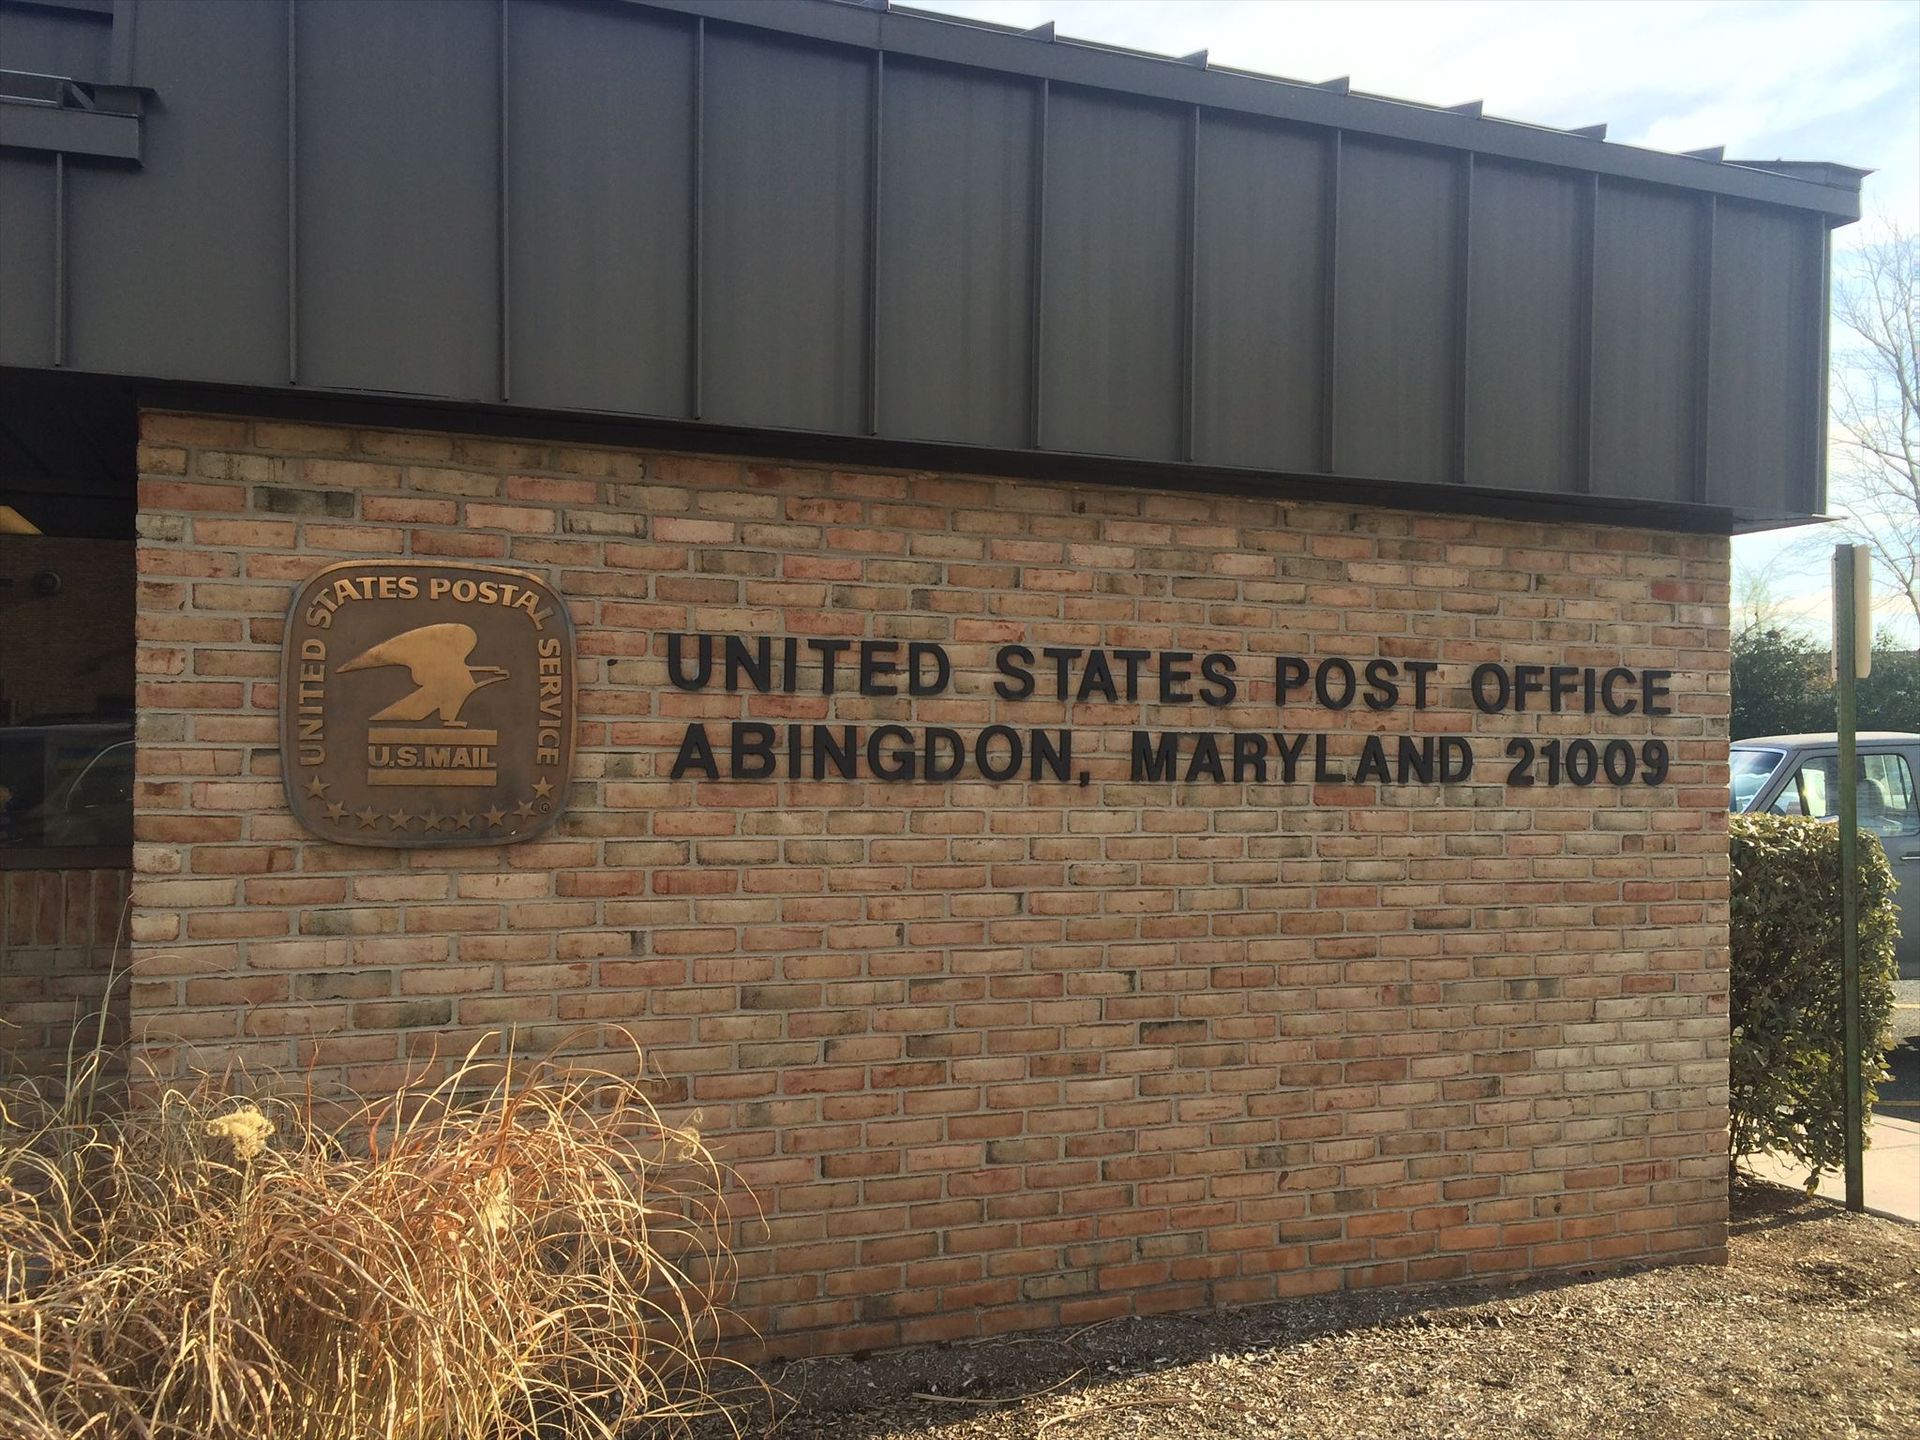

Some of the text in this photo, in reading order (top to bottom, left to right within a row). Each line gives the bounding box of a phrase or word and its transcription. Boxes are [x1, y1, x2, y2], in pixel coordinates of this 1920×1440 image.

[299, 576, 563, 767] UNITED STATES POSTAL SERVICE
[667, 632, 1672, 715] UNITED STATES POST OFFICE
[671, 721, 1670, 788] ABINGDON, MARYLAND 21009
